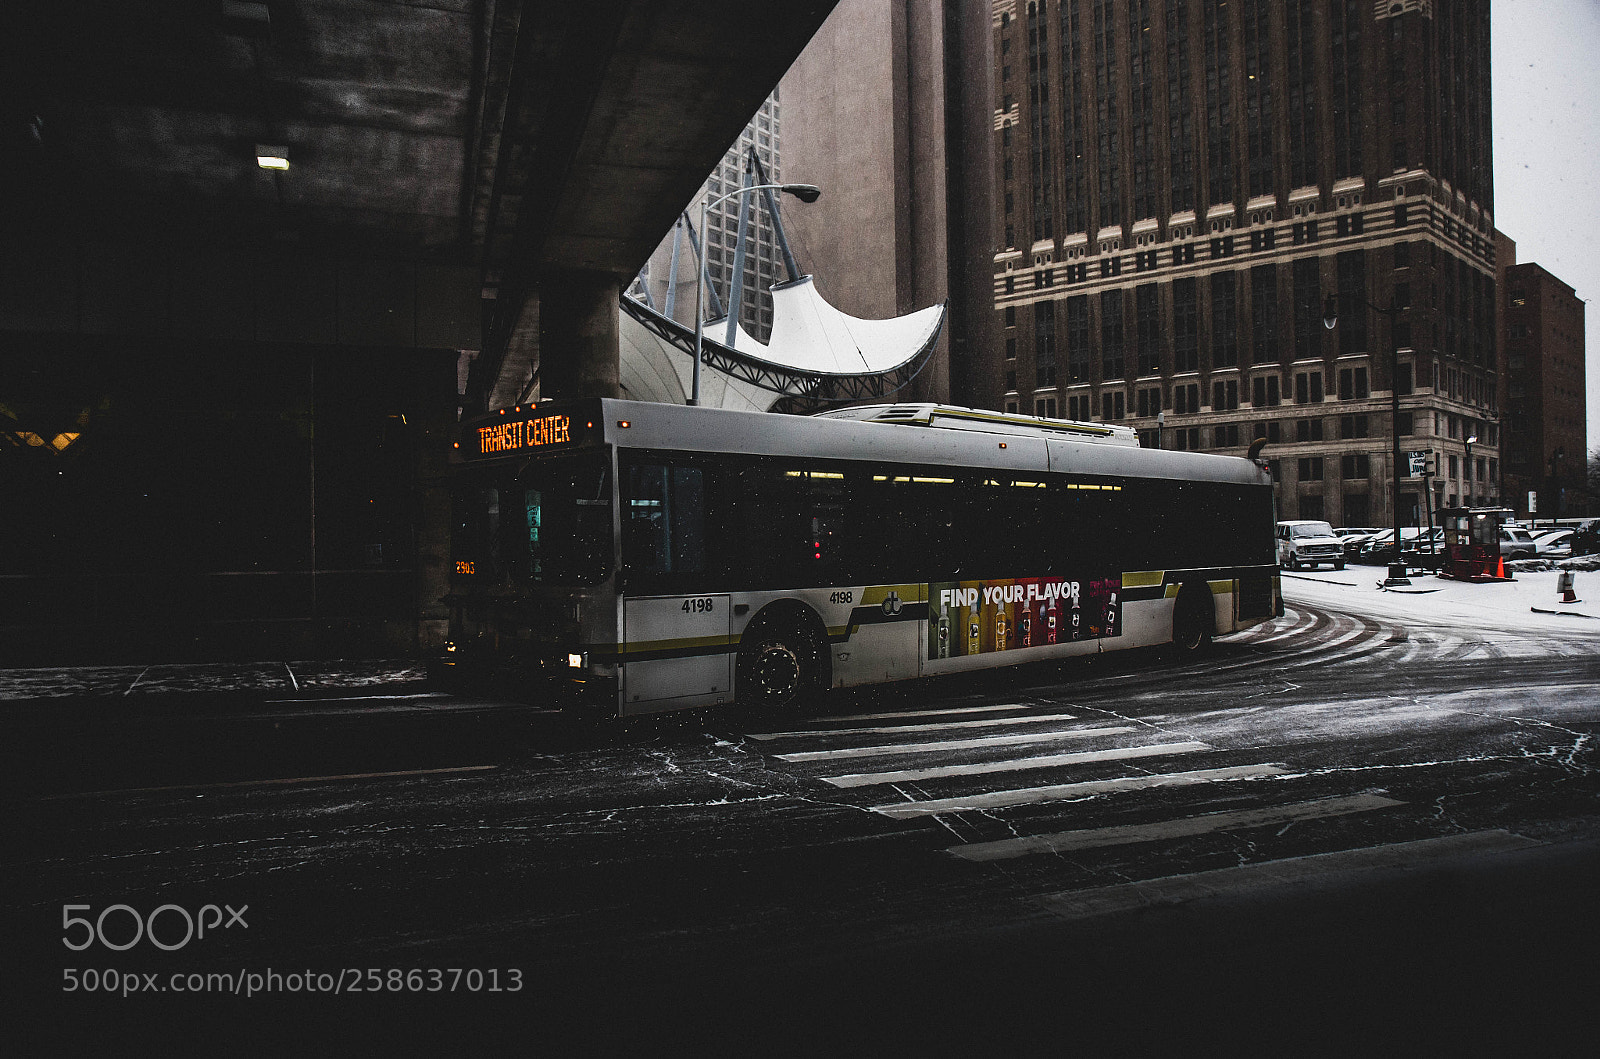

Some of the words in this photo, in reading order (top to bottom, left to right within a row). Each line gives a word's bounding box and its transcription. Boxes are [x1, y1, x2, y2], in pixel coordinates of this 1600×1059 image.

[477, 421, 524, 453] TRANSIT
[527, 415, 570, 446] CENTER
[829, 591, 853, 604] 4198
[940, 588, 979, 608] FIND
[982, 585, 1024, 605] YOUR
[1026, 581, 1081, 600] FLAVOR
[681, 598, 713, 613] 4198
